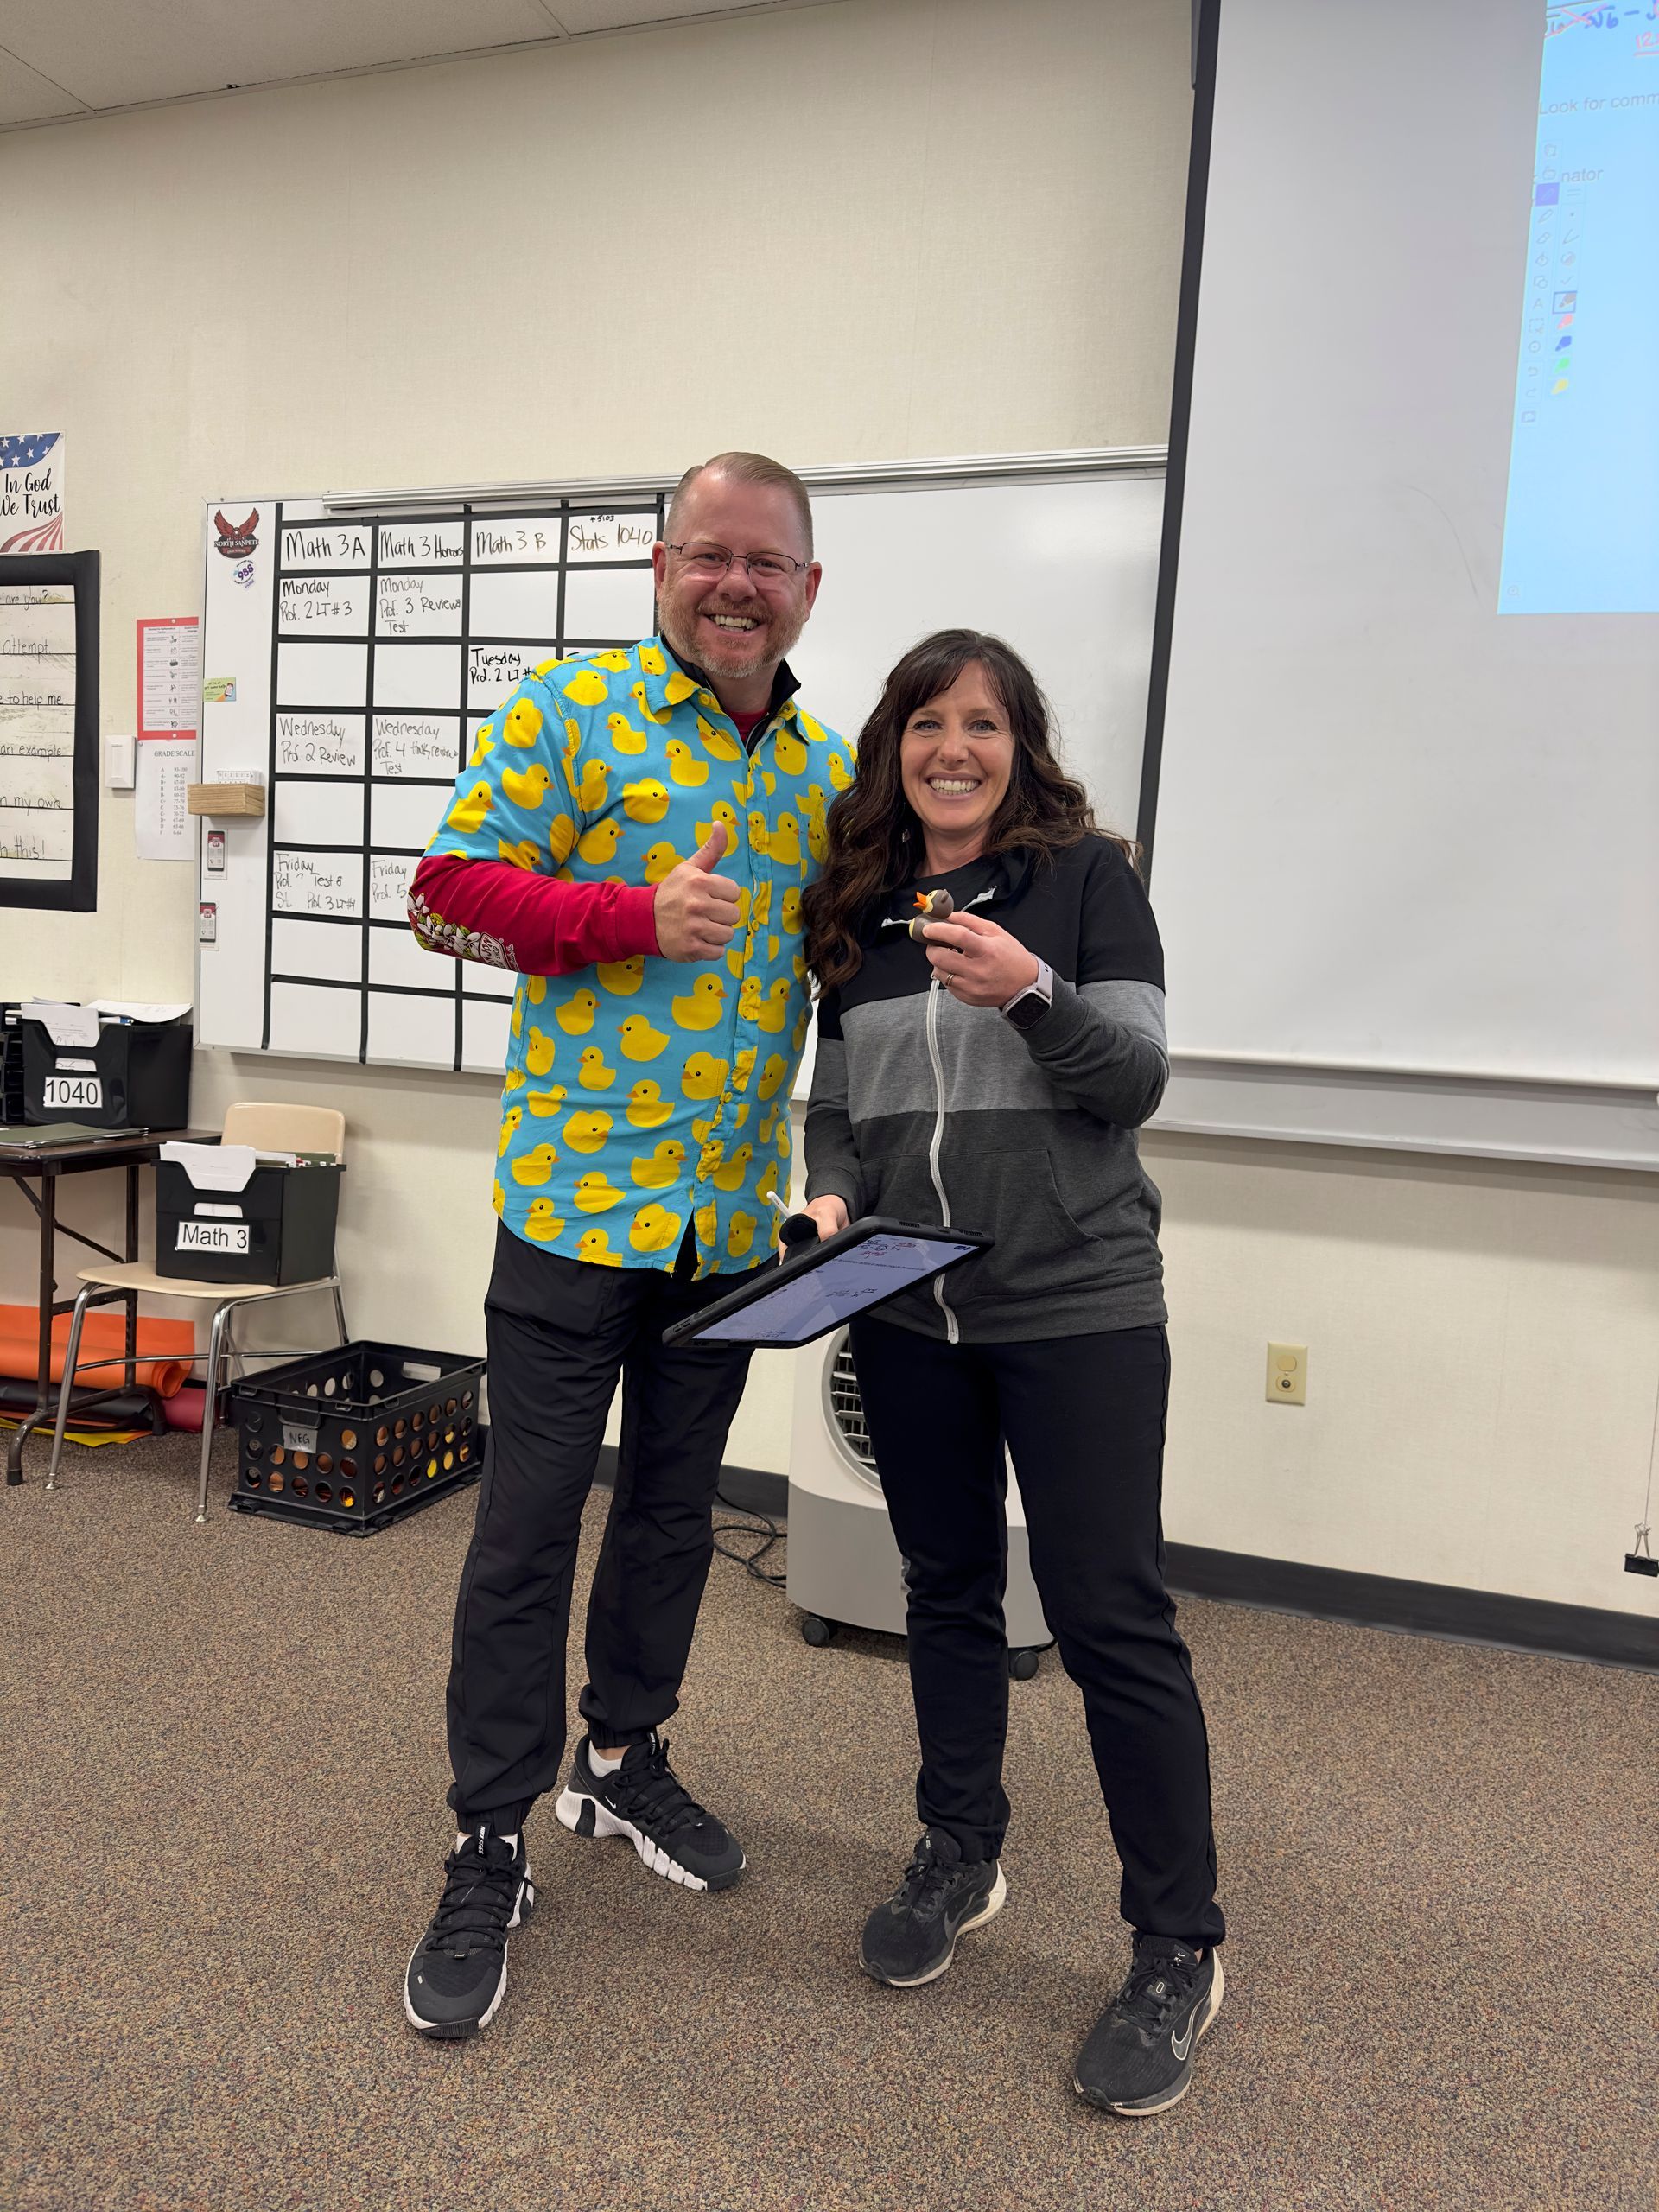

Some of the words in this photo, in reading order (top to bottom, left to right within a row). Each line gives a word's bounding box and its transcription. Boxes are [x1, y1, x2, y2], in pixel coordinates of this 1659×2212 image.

[1539, 99, 1578, 115] Look
[1583, 97, 1606, 111] for
[5, 473, 22, 493] In
[24, 467, 52, 492] God
[22, 493, 61, 518] Trust
[286, 531, 332, 561] Math
[380, 531, 416, 562] Math
[420, 536, 431, 557] 3
[476, 531, 512, 558] Math
[516, 531, 528, 550] 3
[535, 533, 547, 553] B
[569, 524, 609, 553] Stats
[617, 524, 653, 548] 1040
[238, 563, 254, 581] 988
[283, 580, 330, 598] Monday
[380, 577, 423, 595] Monday
[6, 594, 19, 604] are
[405, 597, 414, 614] 3
[305, 601, 313, 619] 2
[385, 620, 410, 635] Test
[471, 647, 521, 667] Tuesday
[494, 668, 502, 682] 2
[8, 690, 20, 704] to
[22, 691, 43, 710] help
[48, 694, 62, 704] me
[279, 717, 346, 747] Wednesday
[375, 718, 440, 740] Wednesday
[0, 745, 14, 755] an
[19, 744, 62, 762] example
[305, 742, 315, 762] 2
[320, 747, 356, 767] Review
[396, 741, 405, 757] 4
[380, 760, 403, 775] Test
[14, 797, 31, 816] my
[37, 798, 61, 809] own
[276, 853, 314, 873] Friday
[372, 860, 407, 879] Friday
[310, 873, 333, 887] Test
[397, 883, 407, 899] 5
[325, 896, 334, 910] 3
[46, 1079, 98, 1105] 1040
[182, 1224, 229, 1247] Math
[237, 1230, 247, 1249] 3
[289, 1432, 310, 1444] NEG
